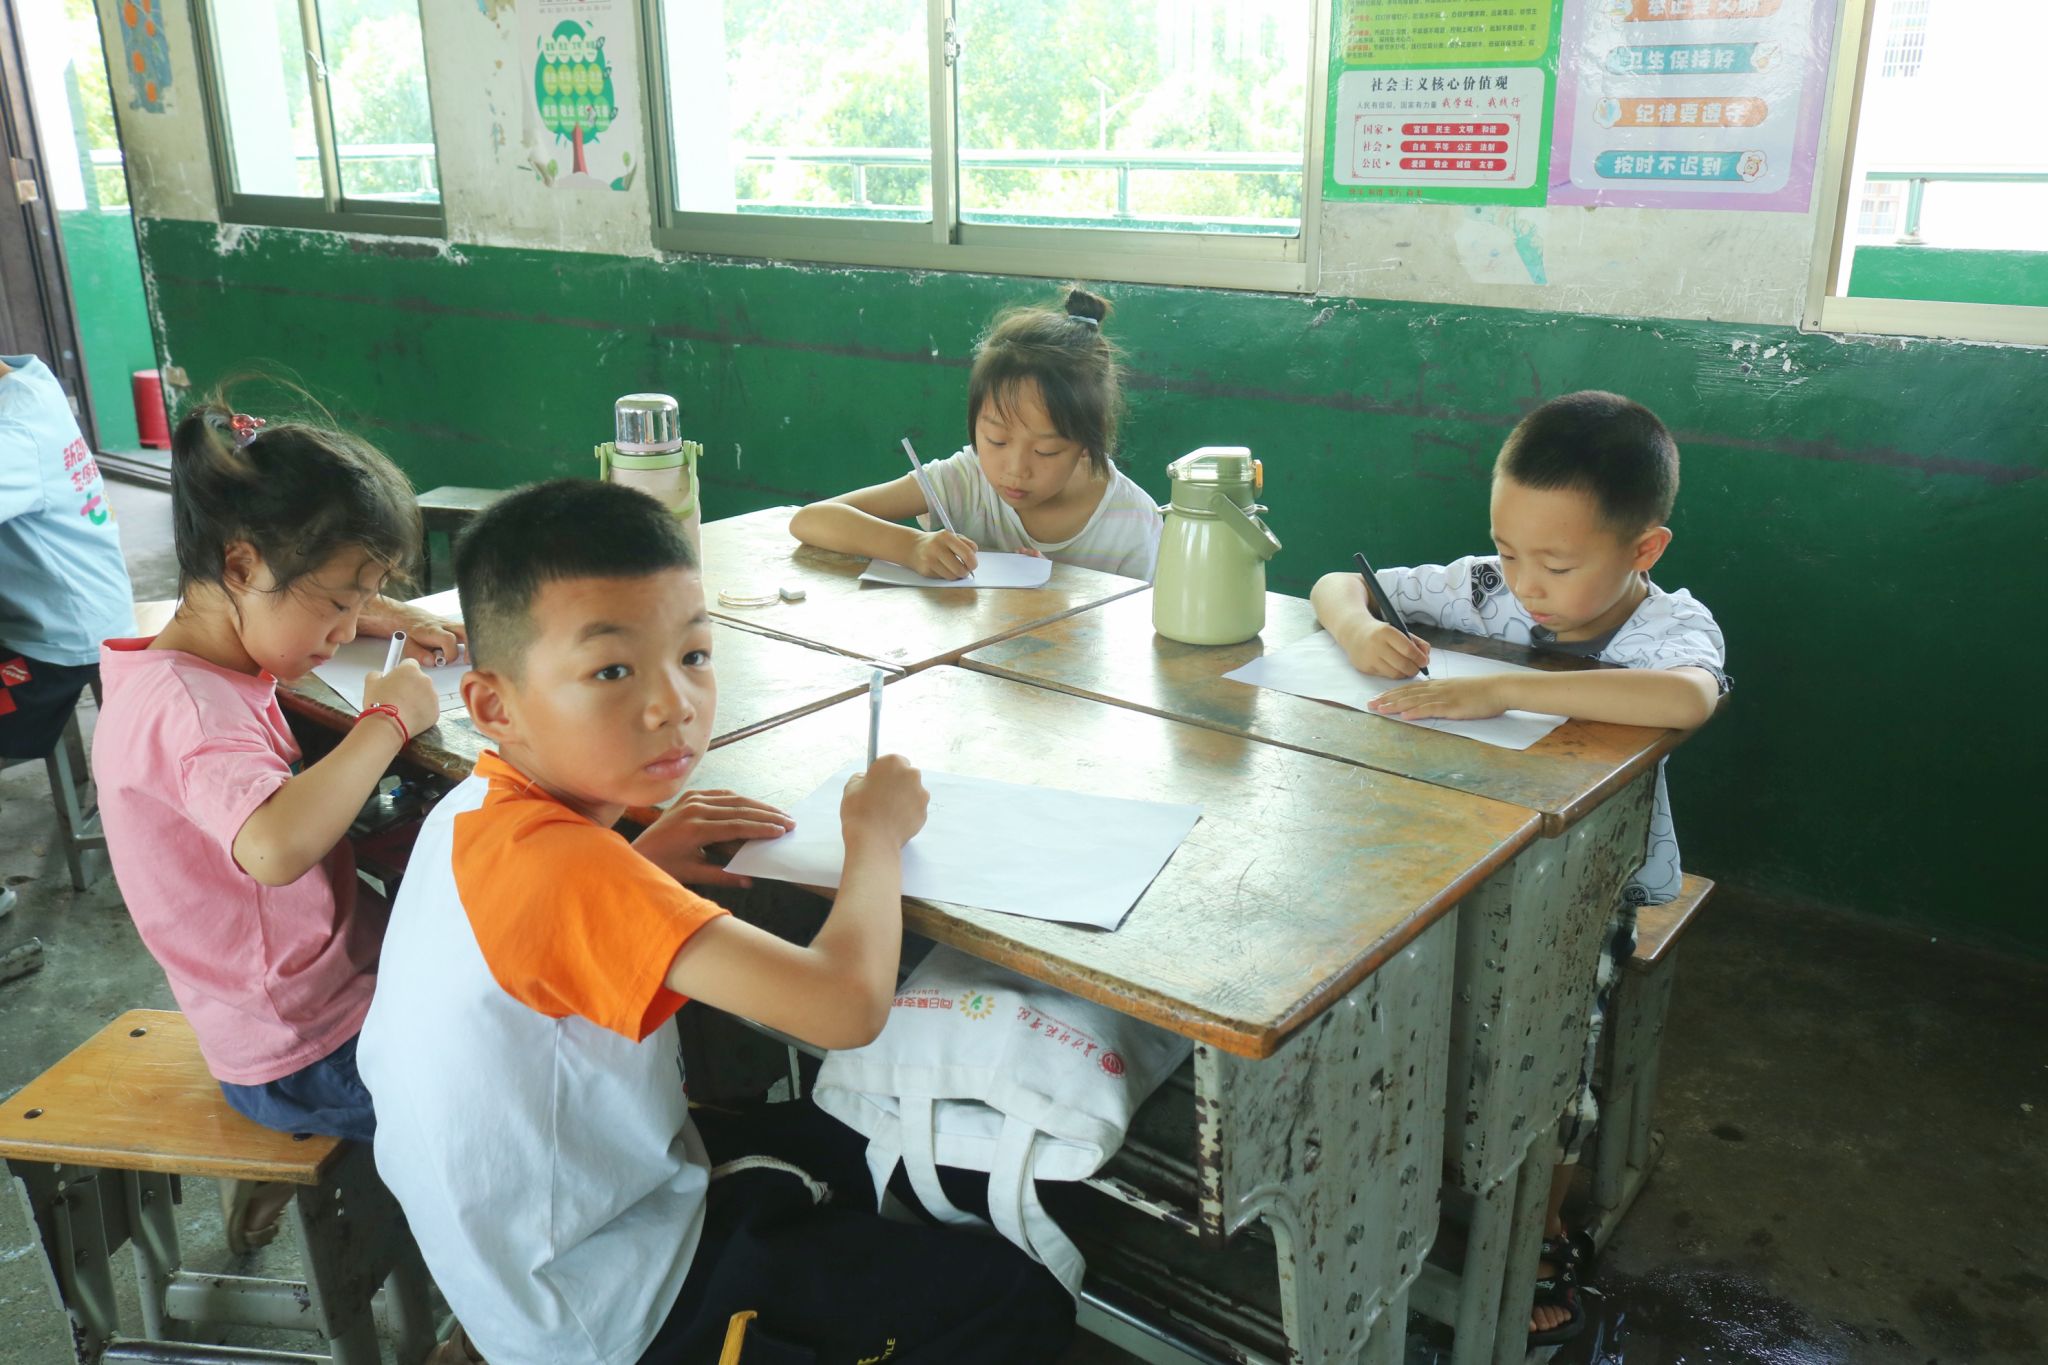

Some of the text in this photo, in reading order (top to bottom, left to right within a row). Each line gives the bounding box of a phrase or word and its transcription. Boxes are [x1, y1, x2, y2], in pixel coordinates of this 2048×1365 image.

[1630, 49, 1736, 70] 卫生保持好
[1371, 76, 1509, 92] 社会主义核心价值观
[1636, 103, 1747, 123] 纪律要遵守
[1363, 124, 1383, 135] 国家
[1436, 125, 1451, 134] 民主
[1459, 125, 1474, 134] 文明
[1482, 125, 1497, 134] 和谐
[1363, 141, 1383, 152] 社会
[1412, 143, 1427, 151] 自由
[1434, 143, 1449, 151] 平等
[1457, 143, 1472, 151] 公正
[1362, 158, 1381, 169] 公民
[1433, 160, 1449, 168] 敬业
[1456, 160, 1471, 169] 诚信
[1479, 161, 1494, 169] 友善
[1614, 155, 1722, 176] 按时不迟到
